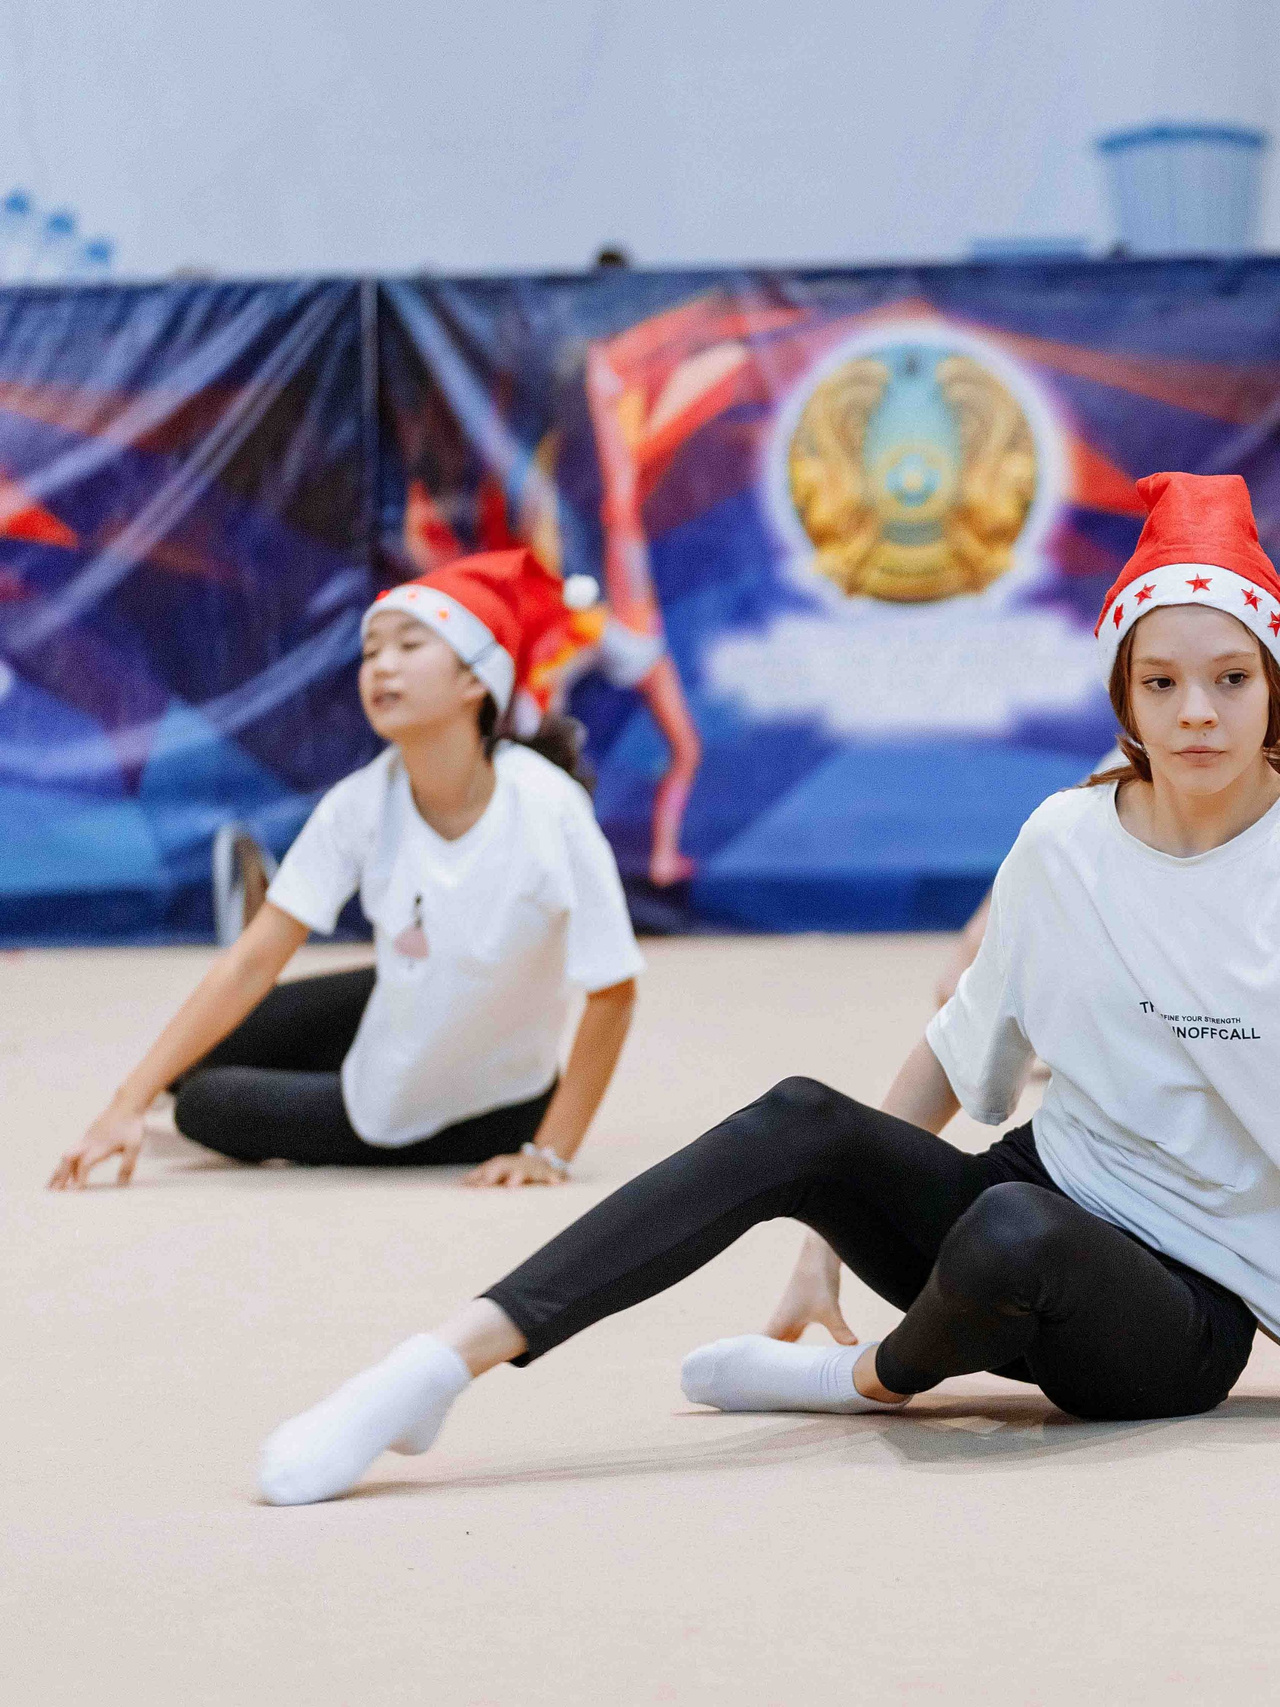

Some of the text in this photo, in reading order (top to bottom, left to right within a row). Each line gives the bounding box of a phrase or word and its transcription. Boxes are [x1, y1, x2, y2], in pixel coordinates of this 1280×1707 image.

[1160, 1013, 1180, 1022] FINE
[1204, 1015, 1241, 1025] STRENGTH
[1172, 1026, 1261, 1041] NOFFCALL
